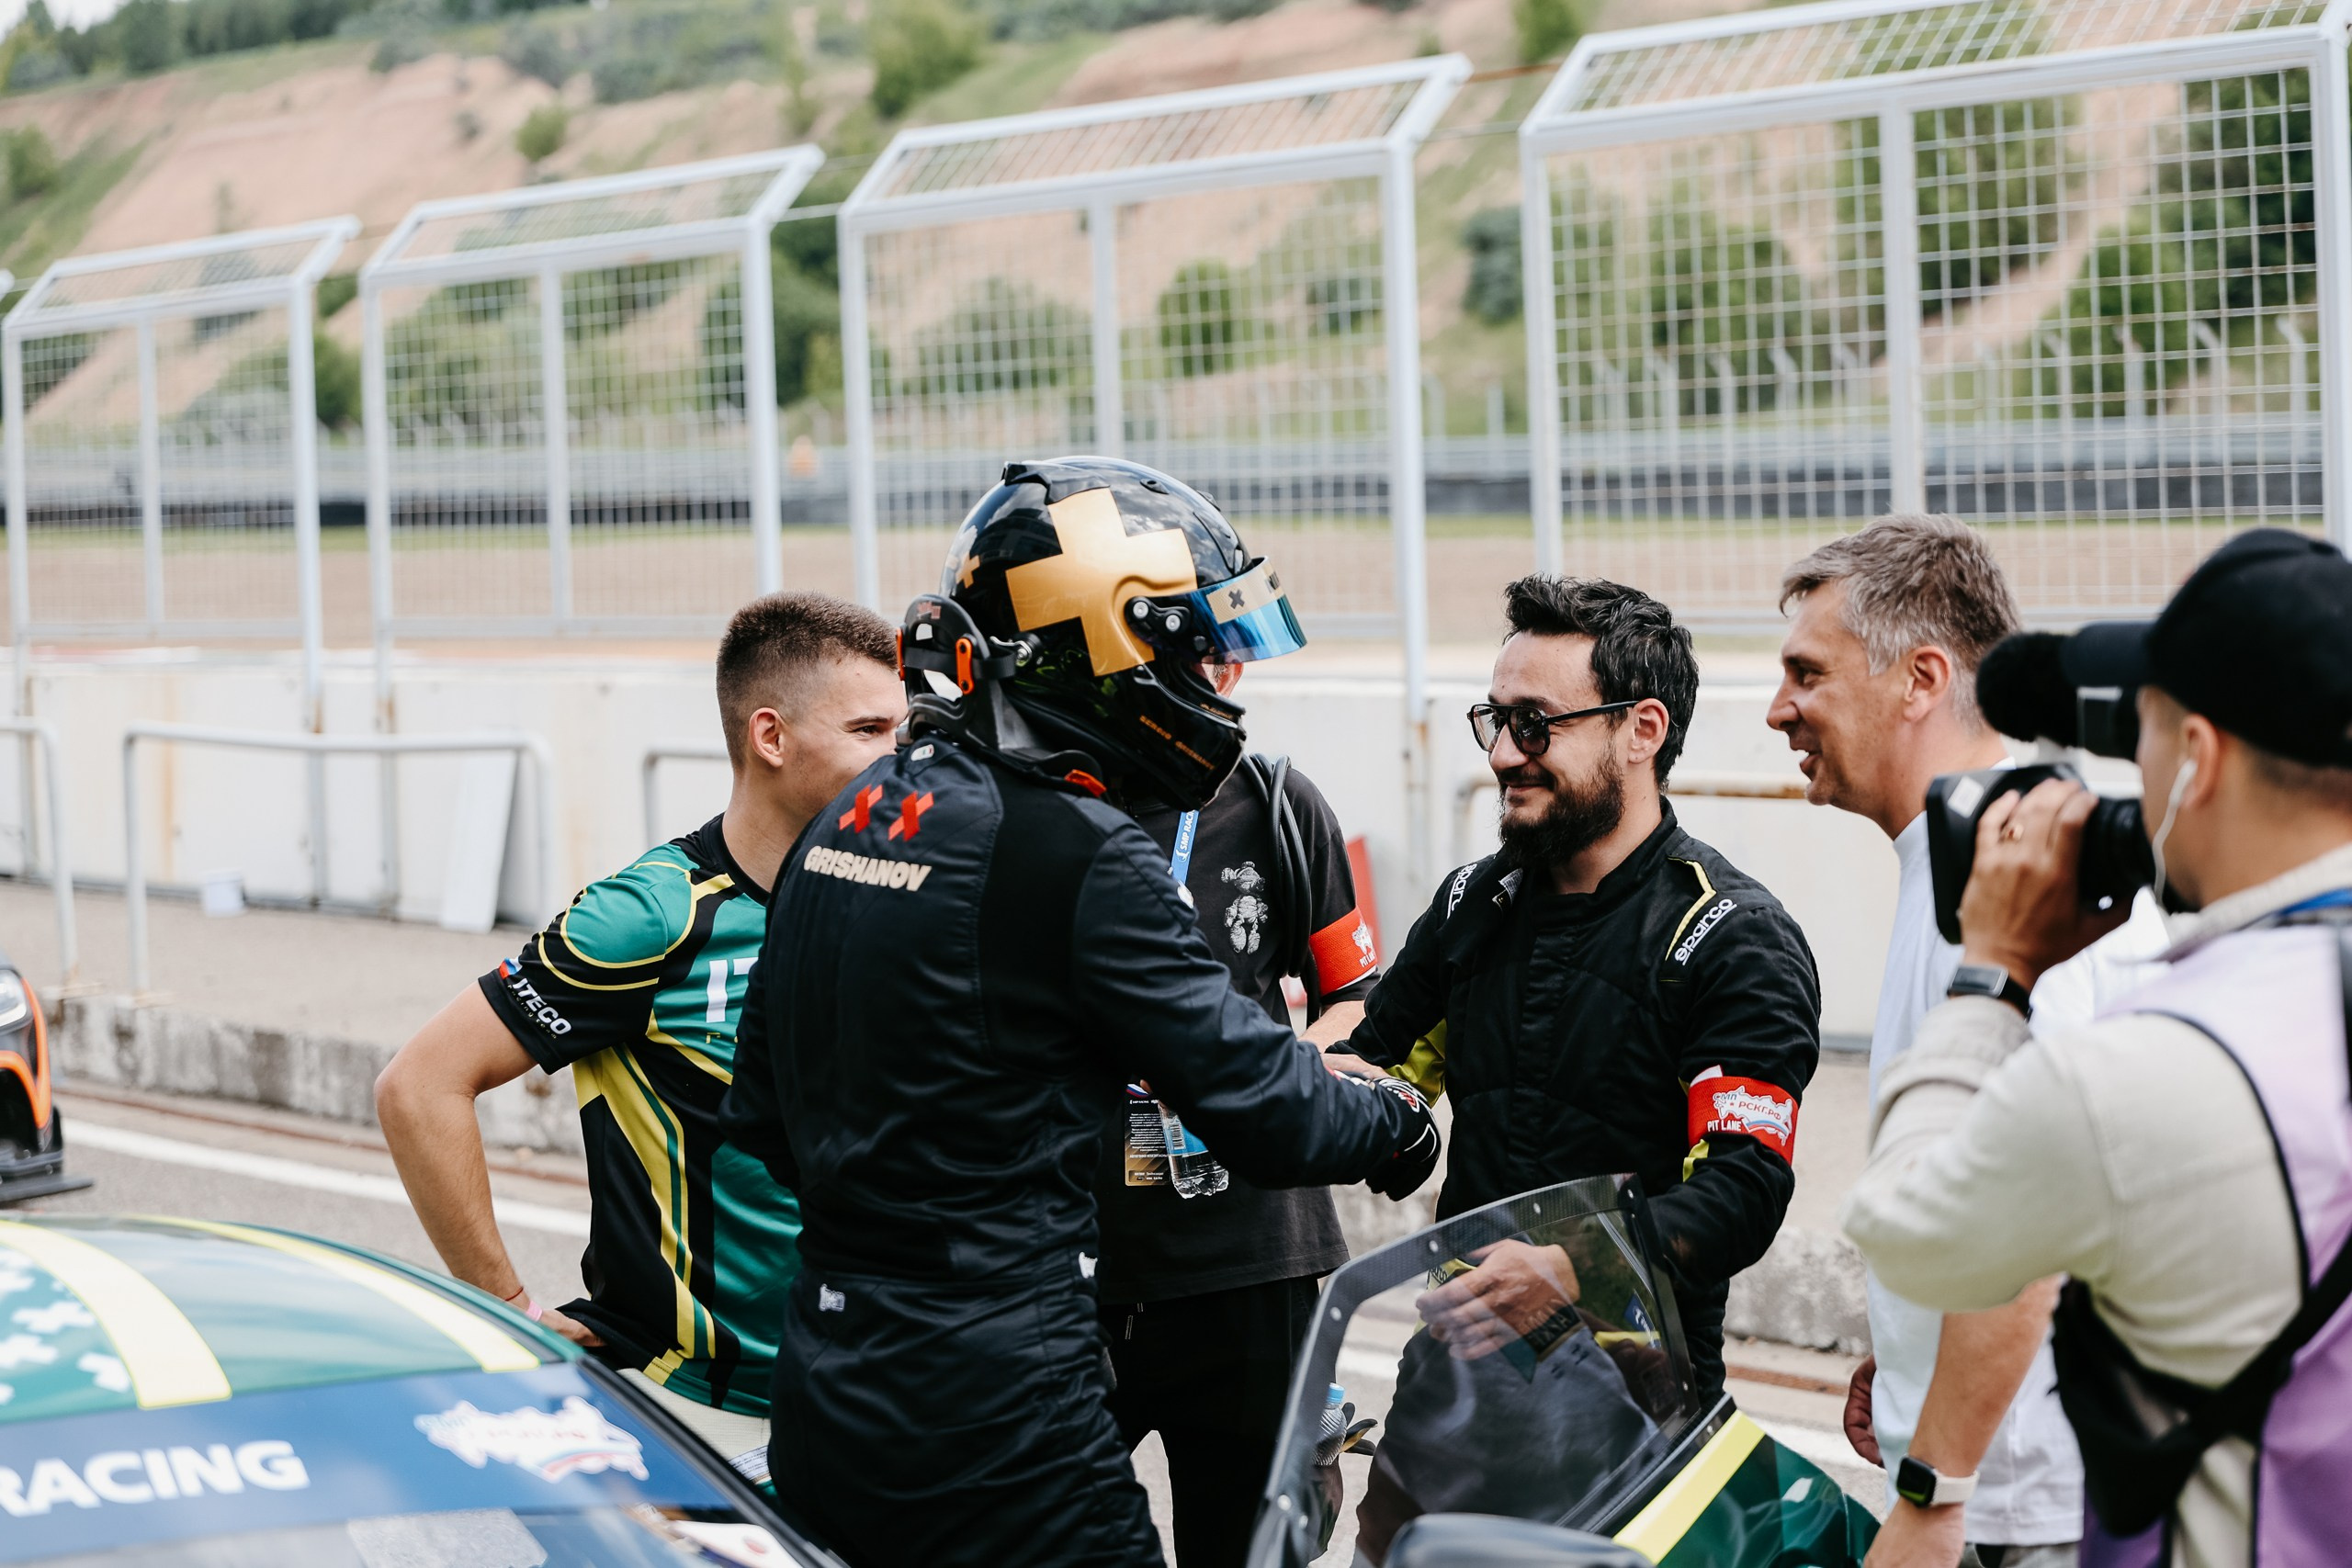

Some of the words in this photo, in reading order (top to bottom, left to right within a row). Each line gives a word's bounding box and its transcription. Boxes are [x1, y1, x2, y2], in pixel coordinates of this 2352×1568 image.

[1180, 832, 1189, 851] SMP
[804, 845, 932, 891] GRISHANOV
[1675, 899, 1736, 964] sparco
[1738, 1101, 1781, 1121] РСКГ.РФ
[1707, 1121, 1720, 1132] PIT
[1721, 1121, 1742, 1132] LANE
